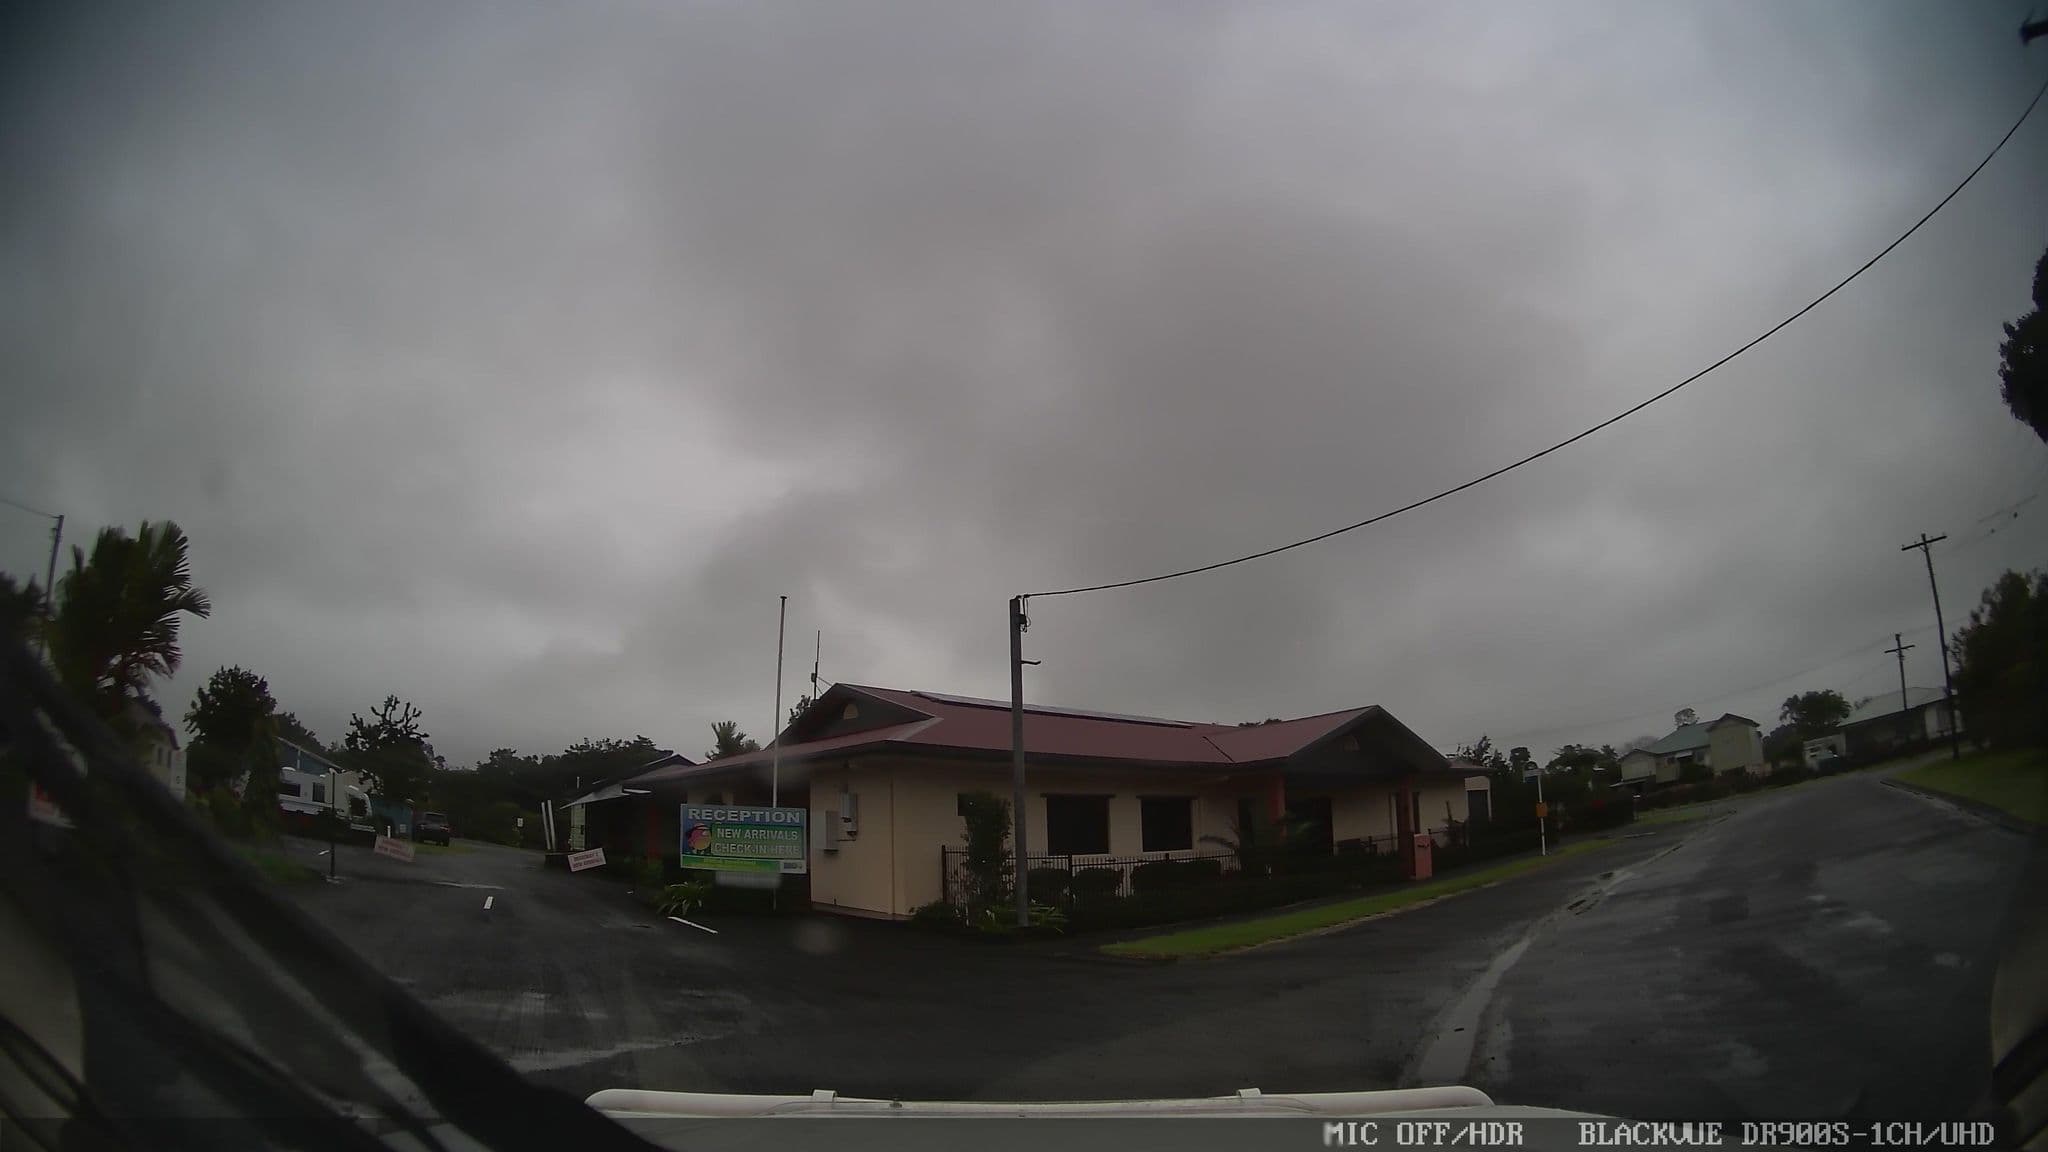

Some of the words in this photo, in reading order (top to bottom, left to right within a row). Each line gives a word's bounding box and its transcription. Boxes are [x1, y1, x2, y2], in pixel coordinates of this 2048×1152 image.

[688, 808, 800, 823] RECEPTION
[717, 828, 741, 839] NEW
[743, 829, 798, 840] ARRIVALS
[772, 845, 800, 856] HERE
